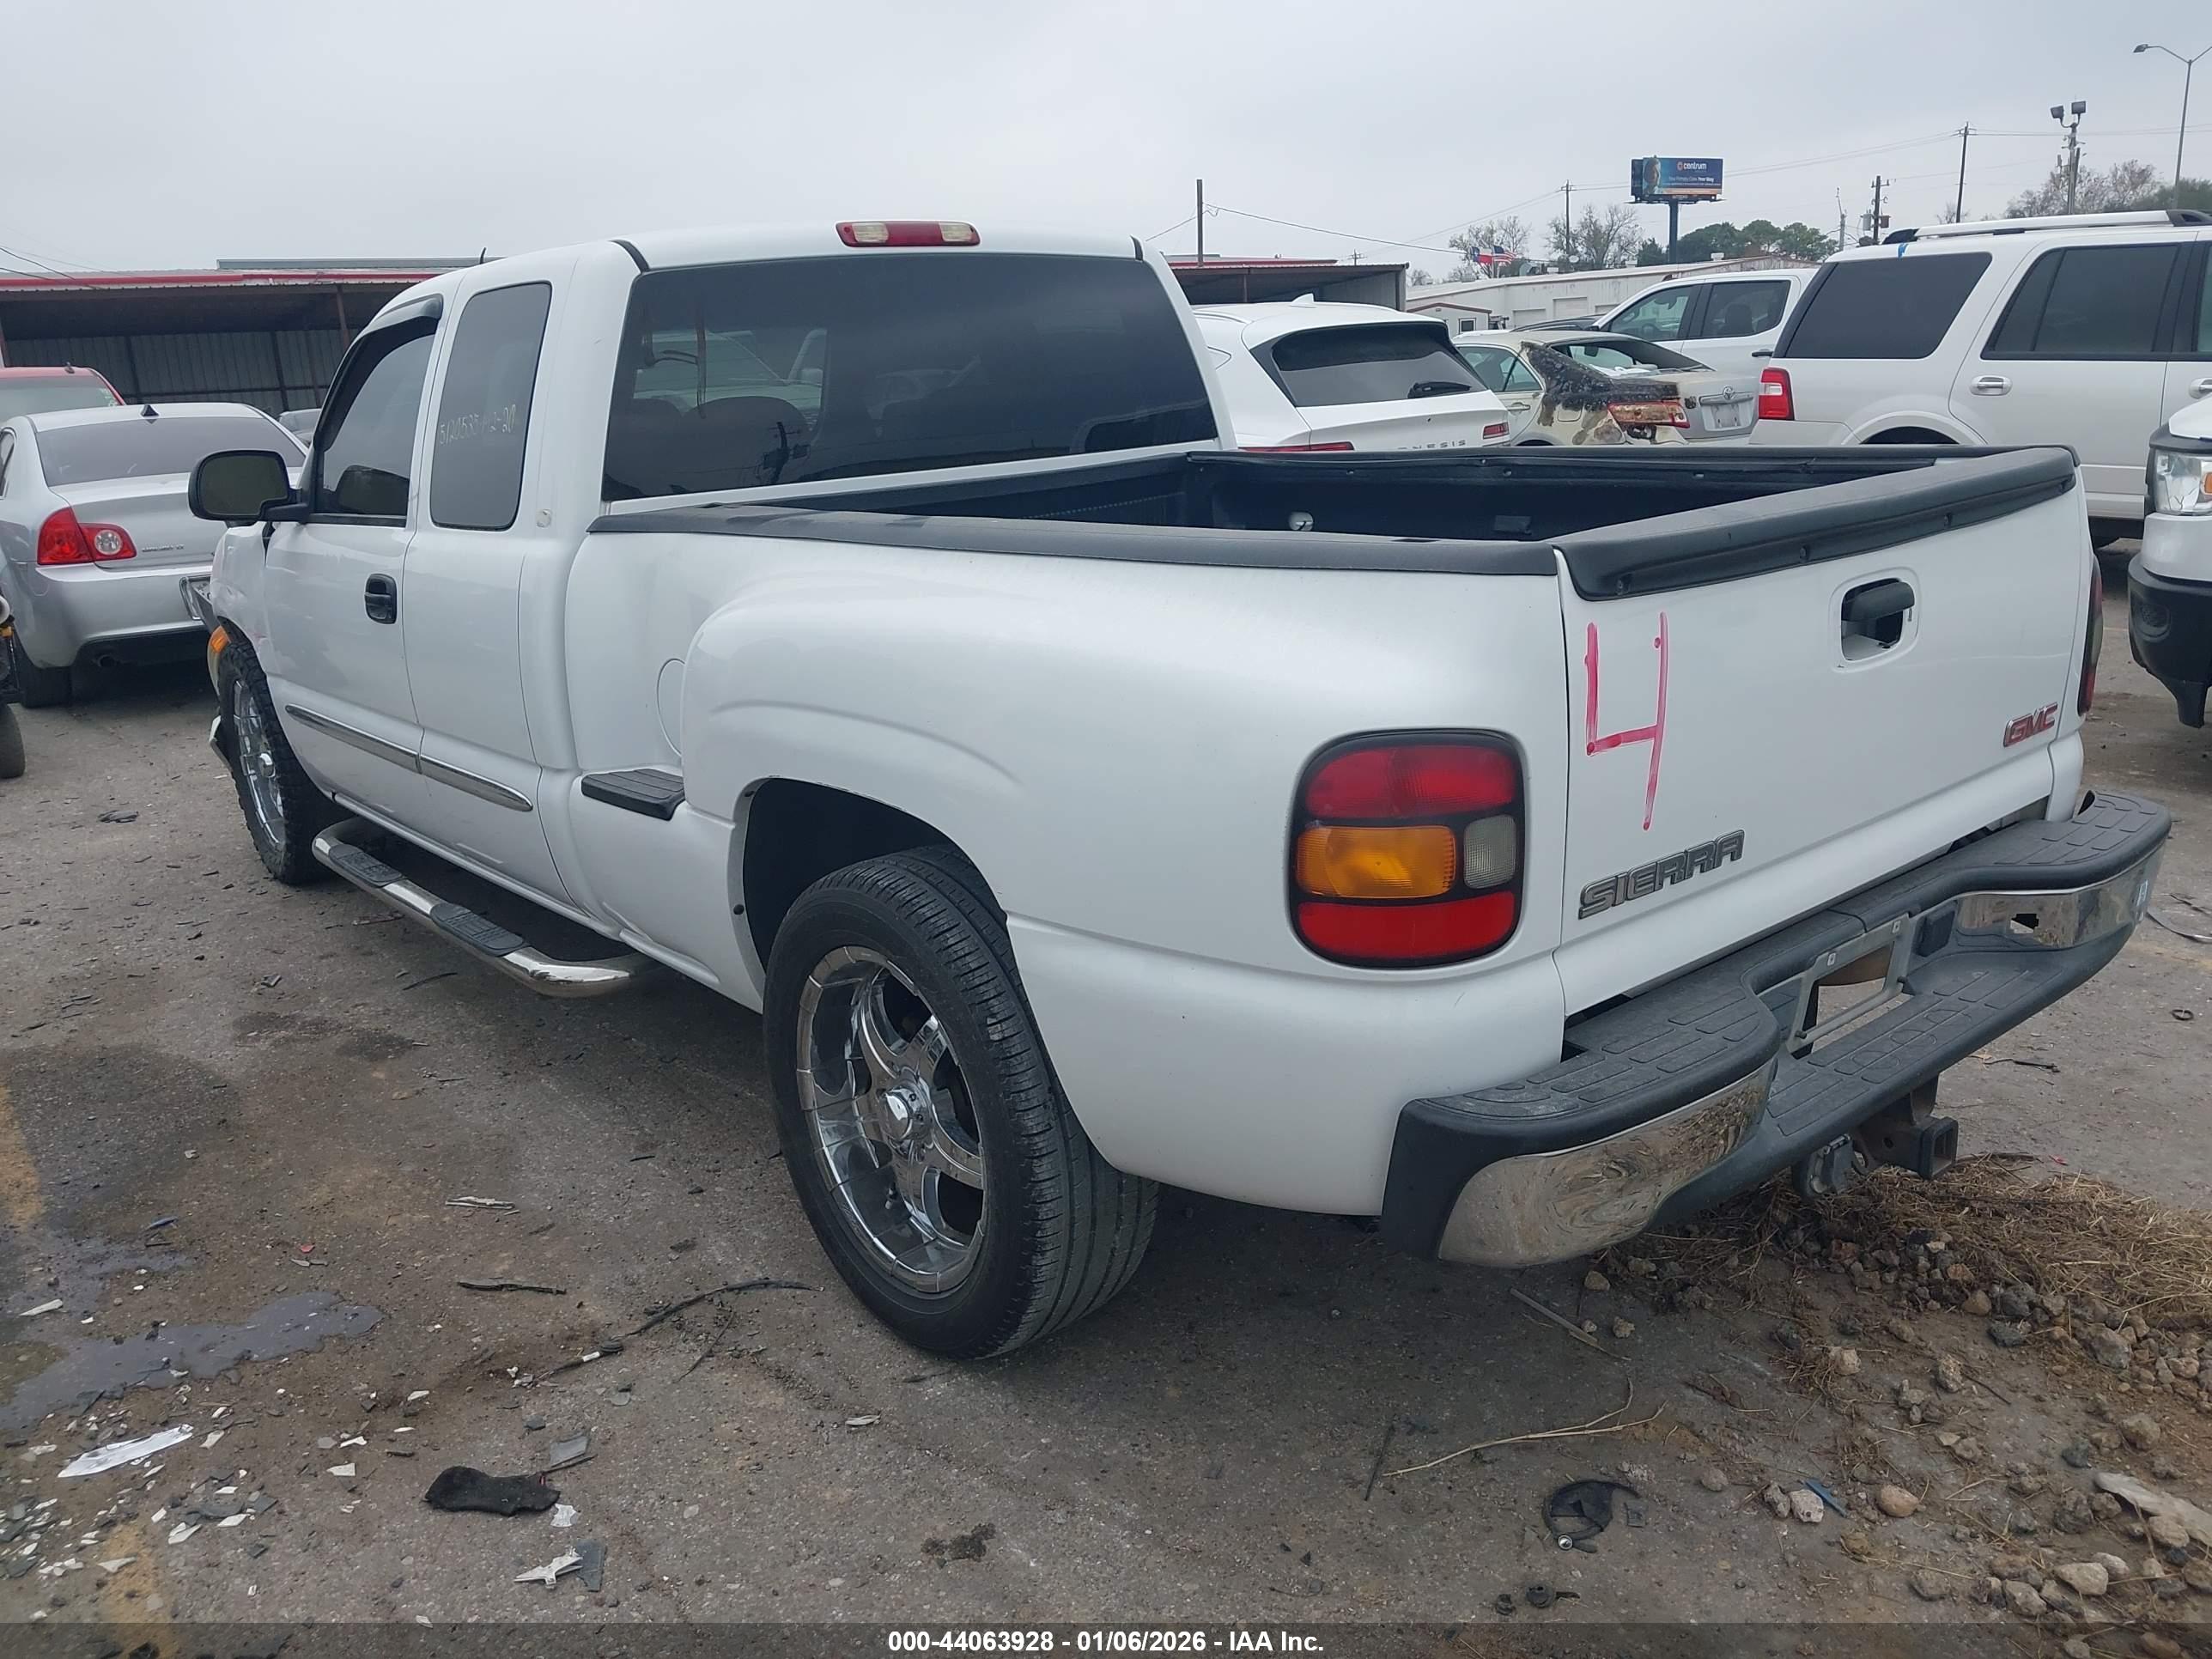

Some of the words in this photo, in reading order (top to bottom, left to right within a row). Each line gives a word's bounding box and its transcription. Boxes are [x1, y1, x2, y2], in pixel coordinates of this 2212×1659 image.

[1683, 161, 1707, 170] centrum
[1398, 439, 1467, 450] NESIS
[1583, 611, 1669, 831] 4
[2003, 702, 2057, 748] GMC
[1578, 829, 1745, 920] SIERRA
